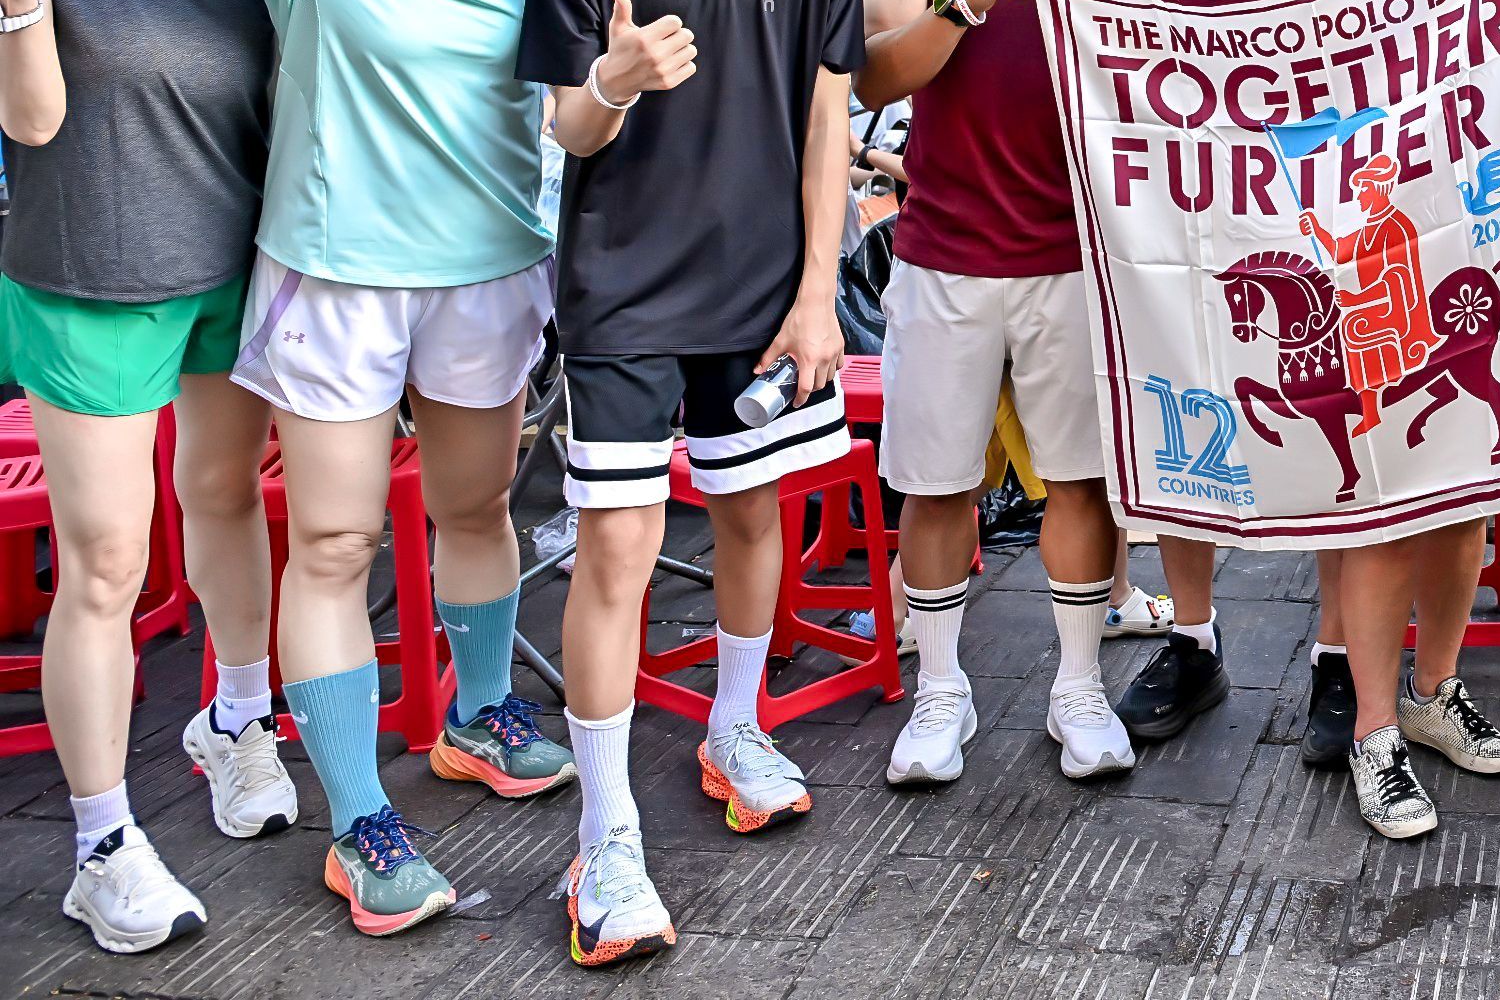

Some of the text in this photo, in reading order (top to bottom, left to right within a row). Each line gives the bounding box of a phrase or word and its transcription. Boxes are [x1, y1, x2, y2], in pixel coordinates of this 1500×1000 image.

[1093, 14, 1163, 51] THE
[1168, 20, 1306, 59] MARCO
[1111, 84, 1491, 217] FURTHER
[1142, 373, 1253, 486] 12
[1157, 475, 1256, 507] COUNTRIES
